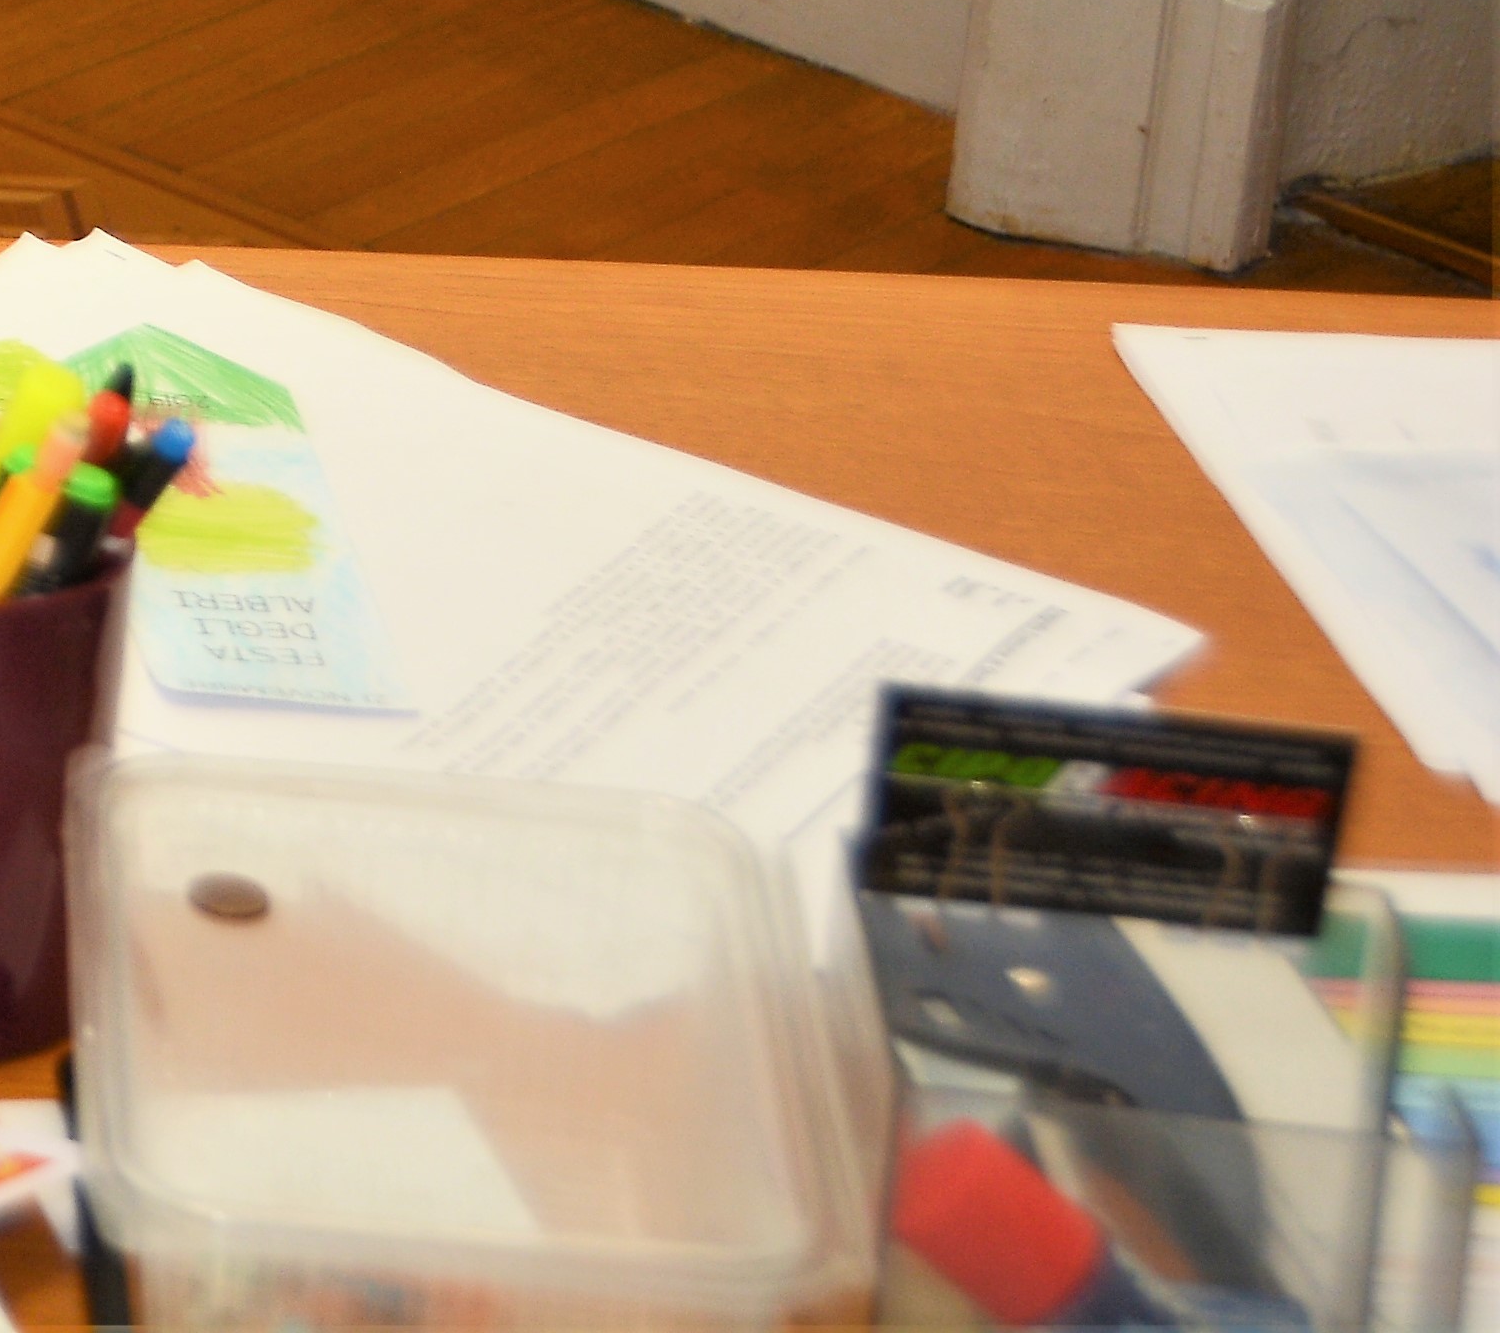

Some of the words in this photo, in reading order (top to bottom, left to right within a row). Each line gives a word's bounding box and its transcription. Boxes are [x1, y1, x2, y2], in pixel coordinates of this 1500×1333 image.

[167, 589, 315, 614] ALBERI
[191, 617, 317, 641] DEGLI
[203, 643, 326, 667] FESTA
